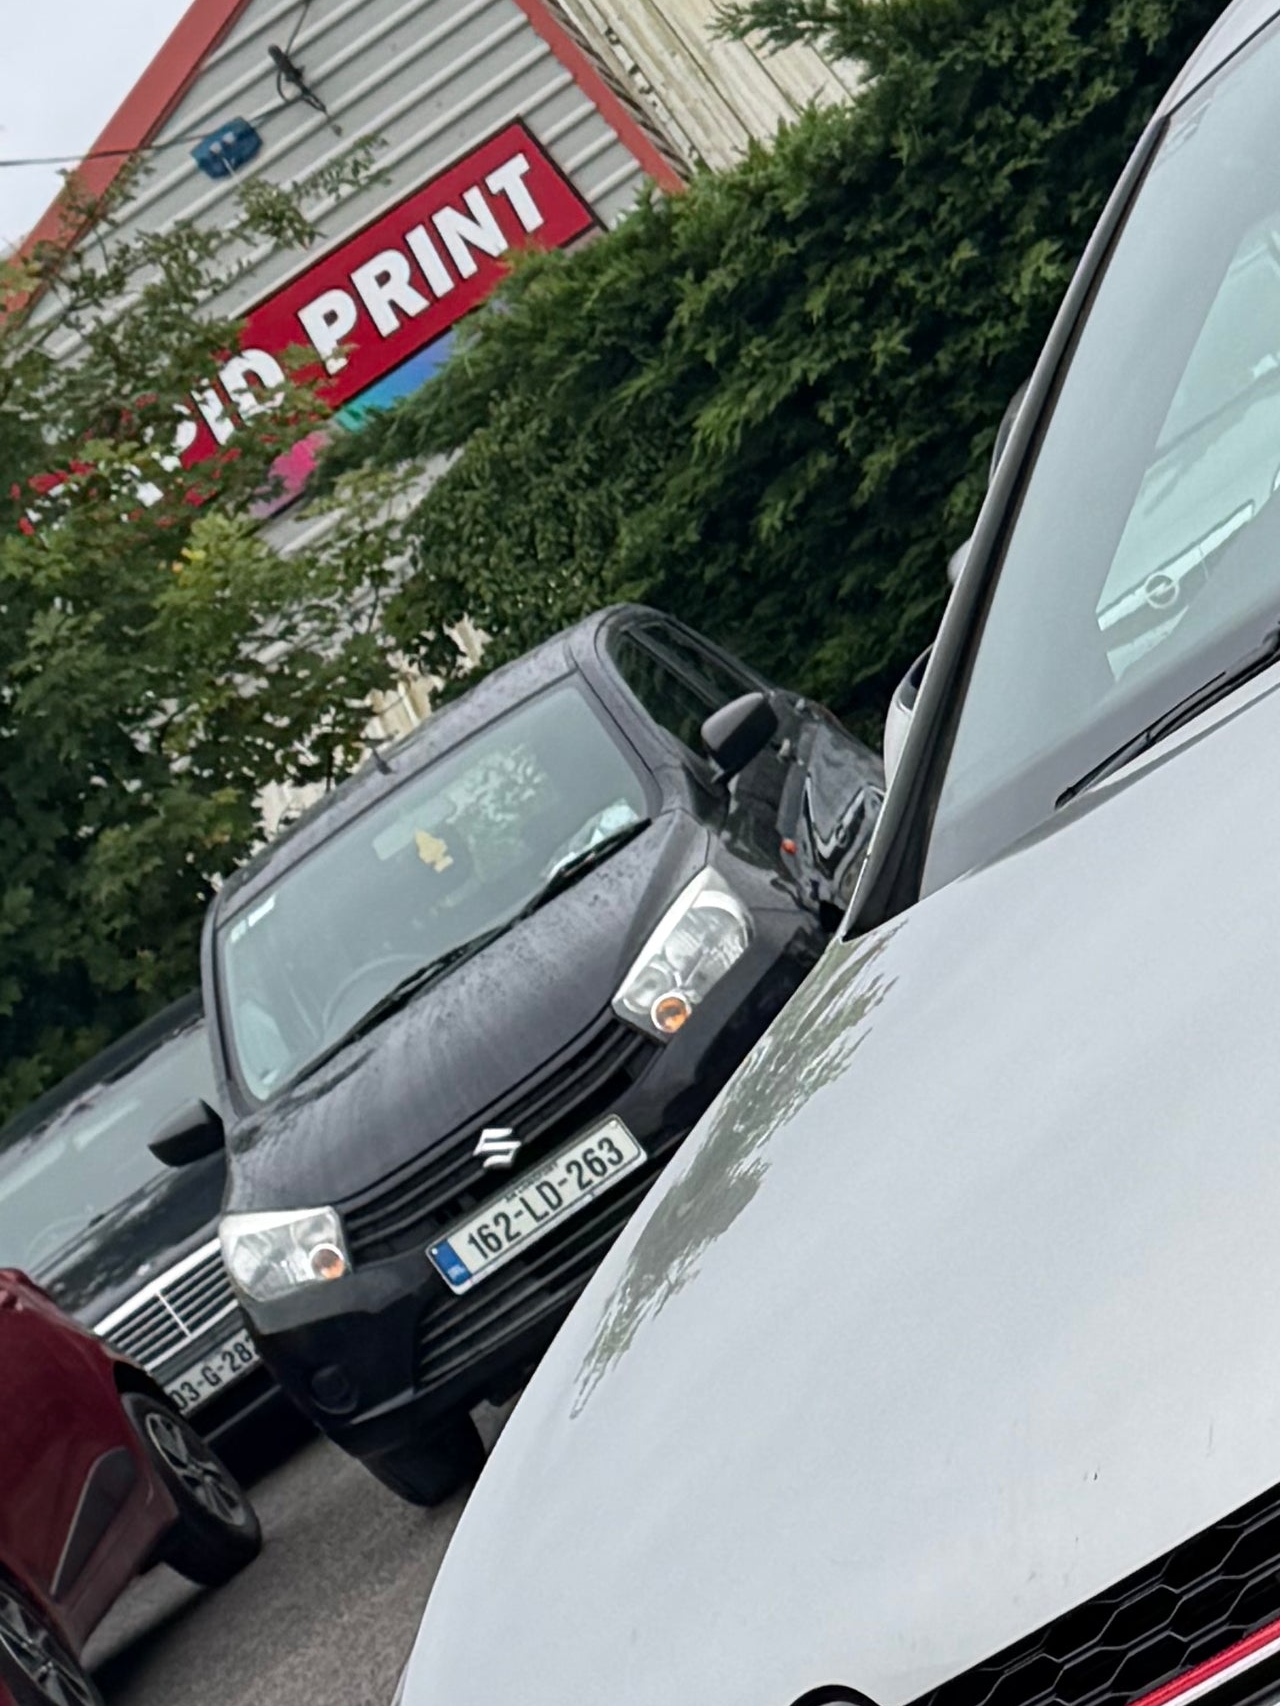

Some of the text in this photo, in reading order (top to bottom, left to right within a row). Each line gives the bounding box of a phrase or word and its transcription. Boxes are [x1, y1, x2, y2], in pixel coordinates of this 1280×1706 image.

[297, 152, 545, 375] PRINT
[467, 1137, 624, 1260] 162-LD-263
[168, 1333, 255, 1411] 03-G-28
